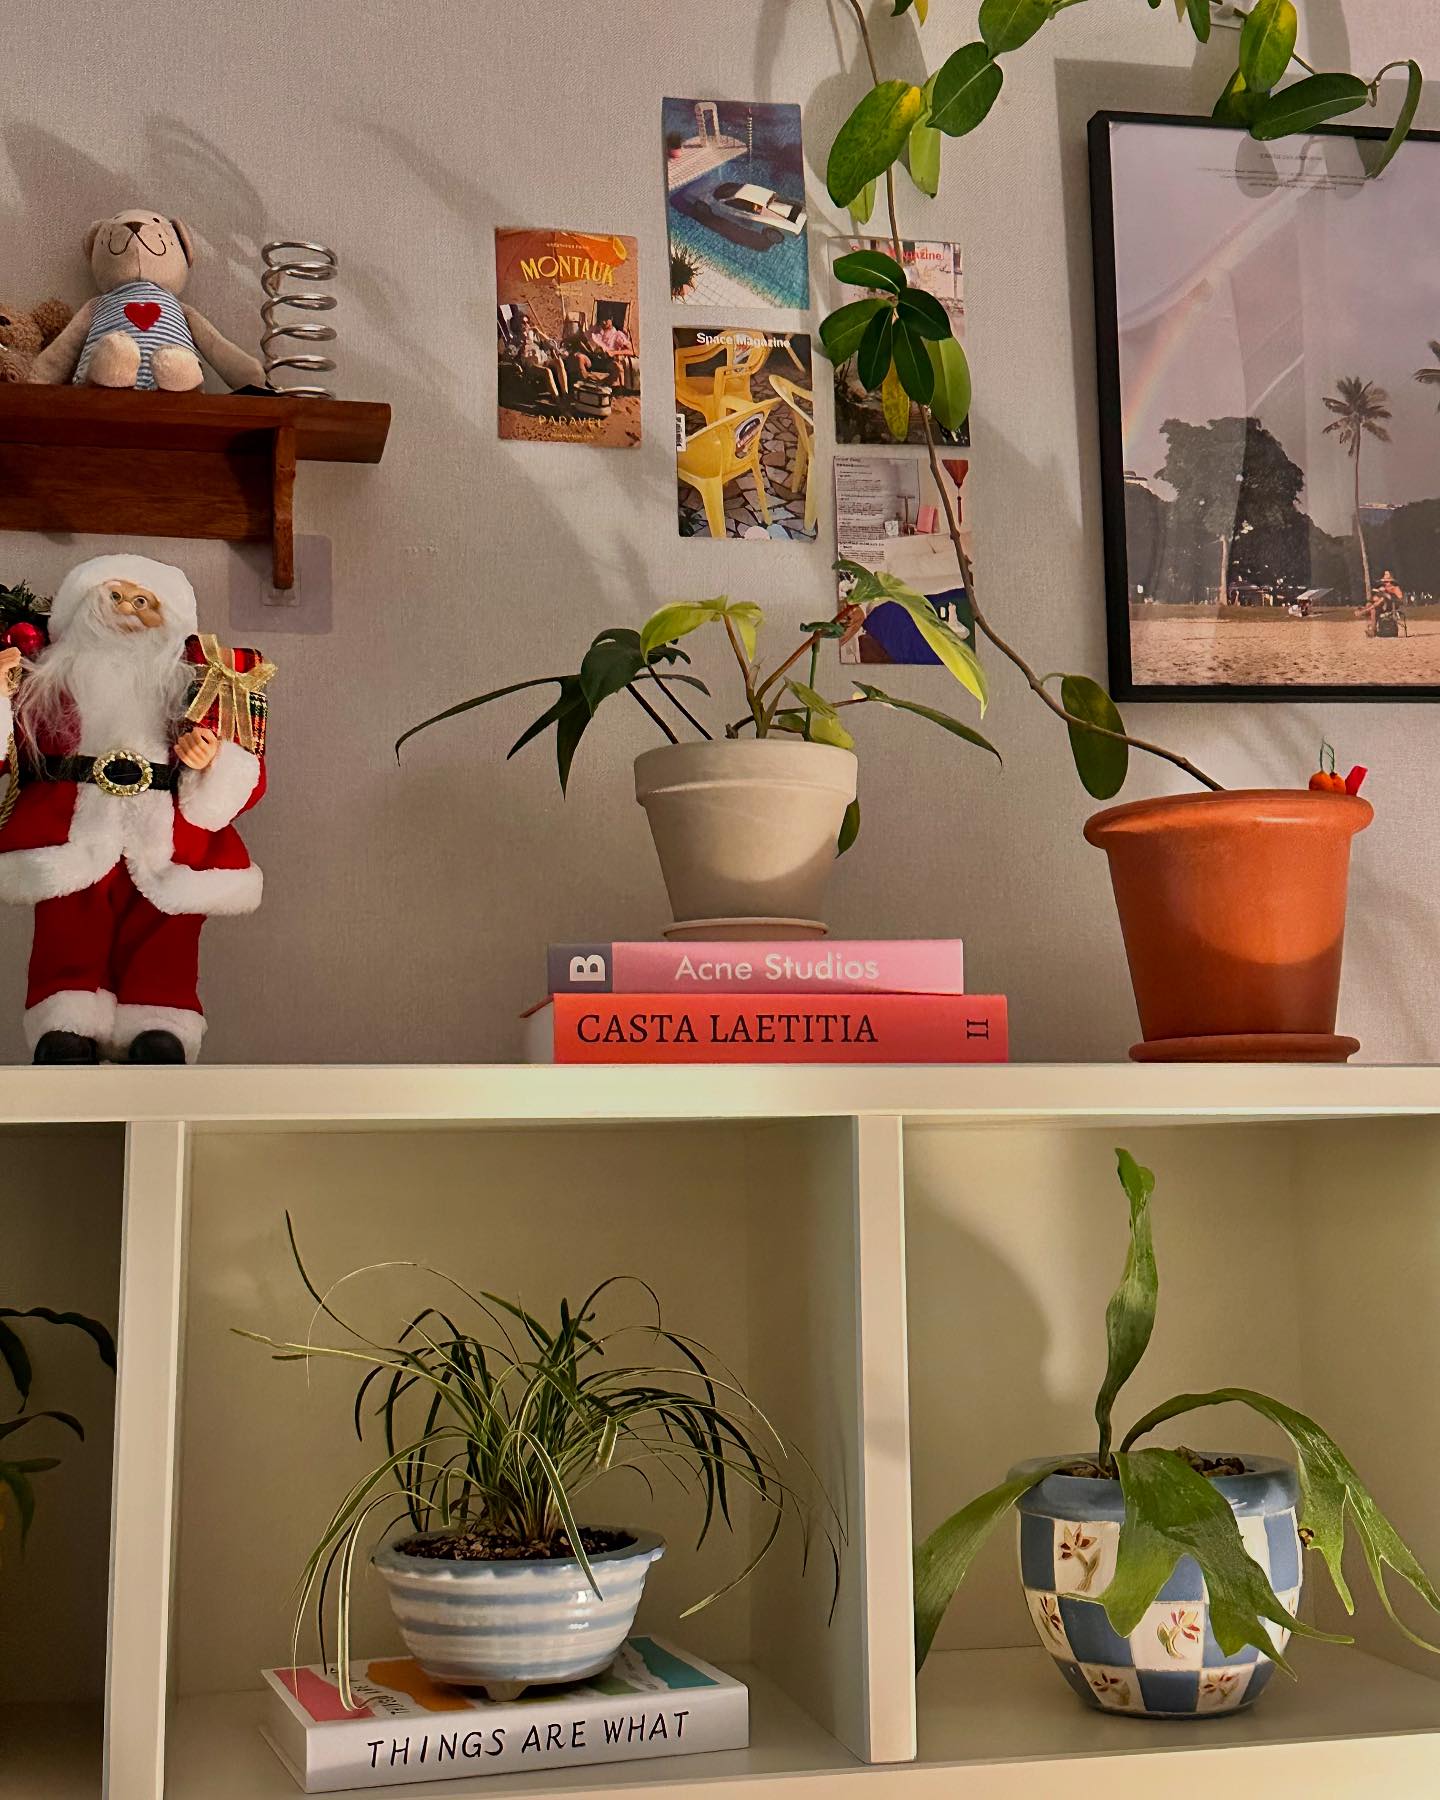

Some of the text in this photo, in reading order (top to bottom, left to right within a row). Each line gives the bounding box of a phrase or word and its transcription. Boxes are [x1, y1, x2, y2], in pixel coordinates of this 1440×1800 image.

[520, 255, 614, 287] MONTAUK
[696, 332, 791, 348] Space Magazine
[569, 954, 606, 981] B
[674, 951, 880, 981] Acne Studios
[577, 1014, 878, 1043] CASTA LAETITIA
[367, 1710, 689, 1769] THINGS ARE WHAT
